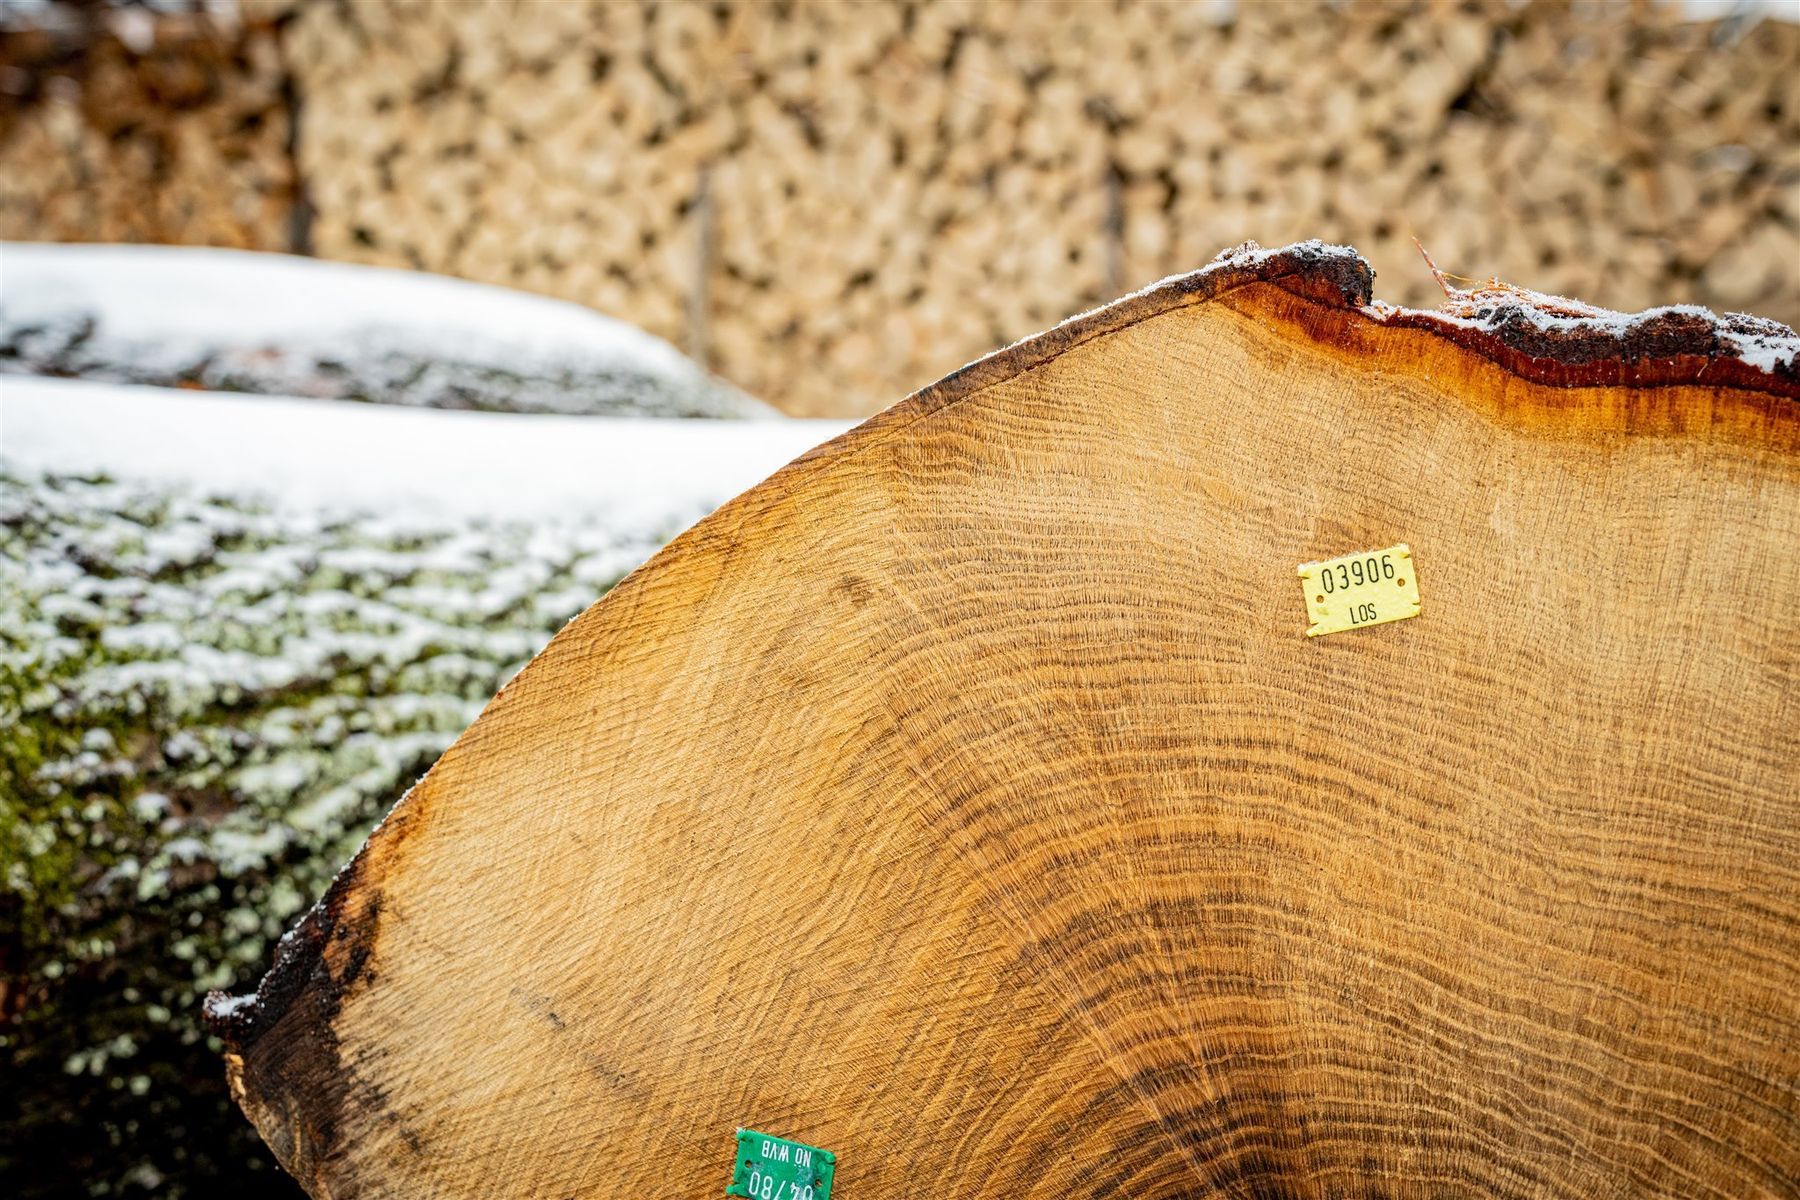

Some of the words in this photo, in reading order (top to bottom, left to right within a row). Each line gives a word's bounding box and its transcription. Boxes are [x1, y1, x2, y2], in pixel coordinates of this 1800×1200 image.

[1321, 555, 1394, 594] 03906
[1349, 602, 1377, 624] LOS
[761, 1140, 790, 1163] WVB
[794, 1147, 812, 1168] NÖ
